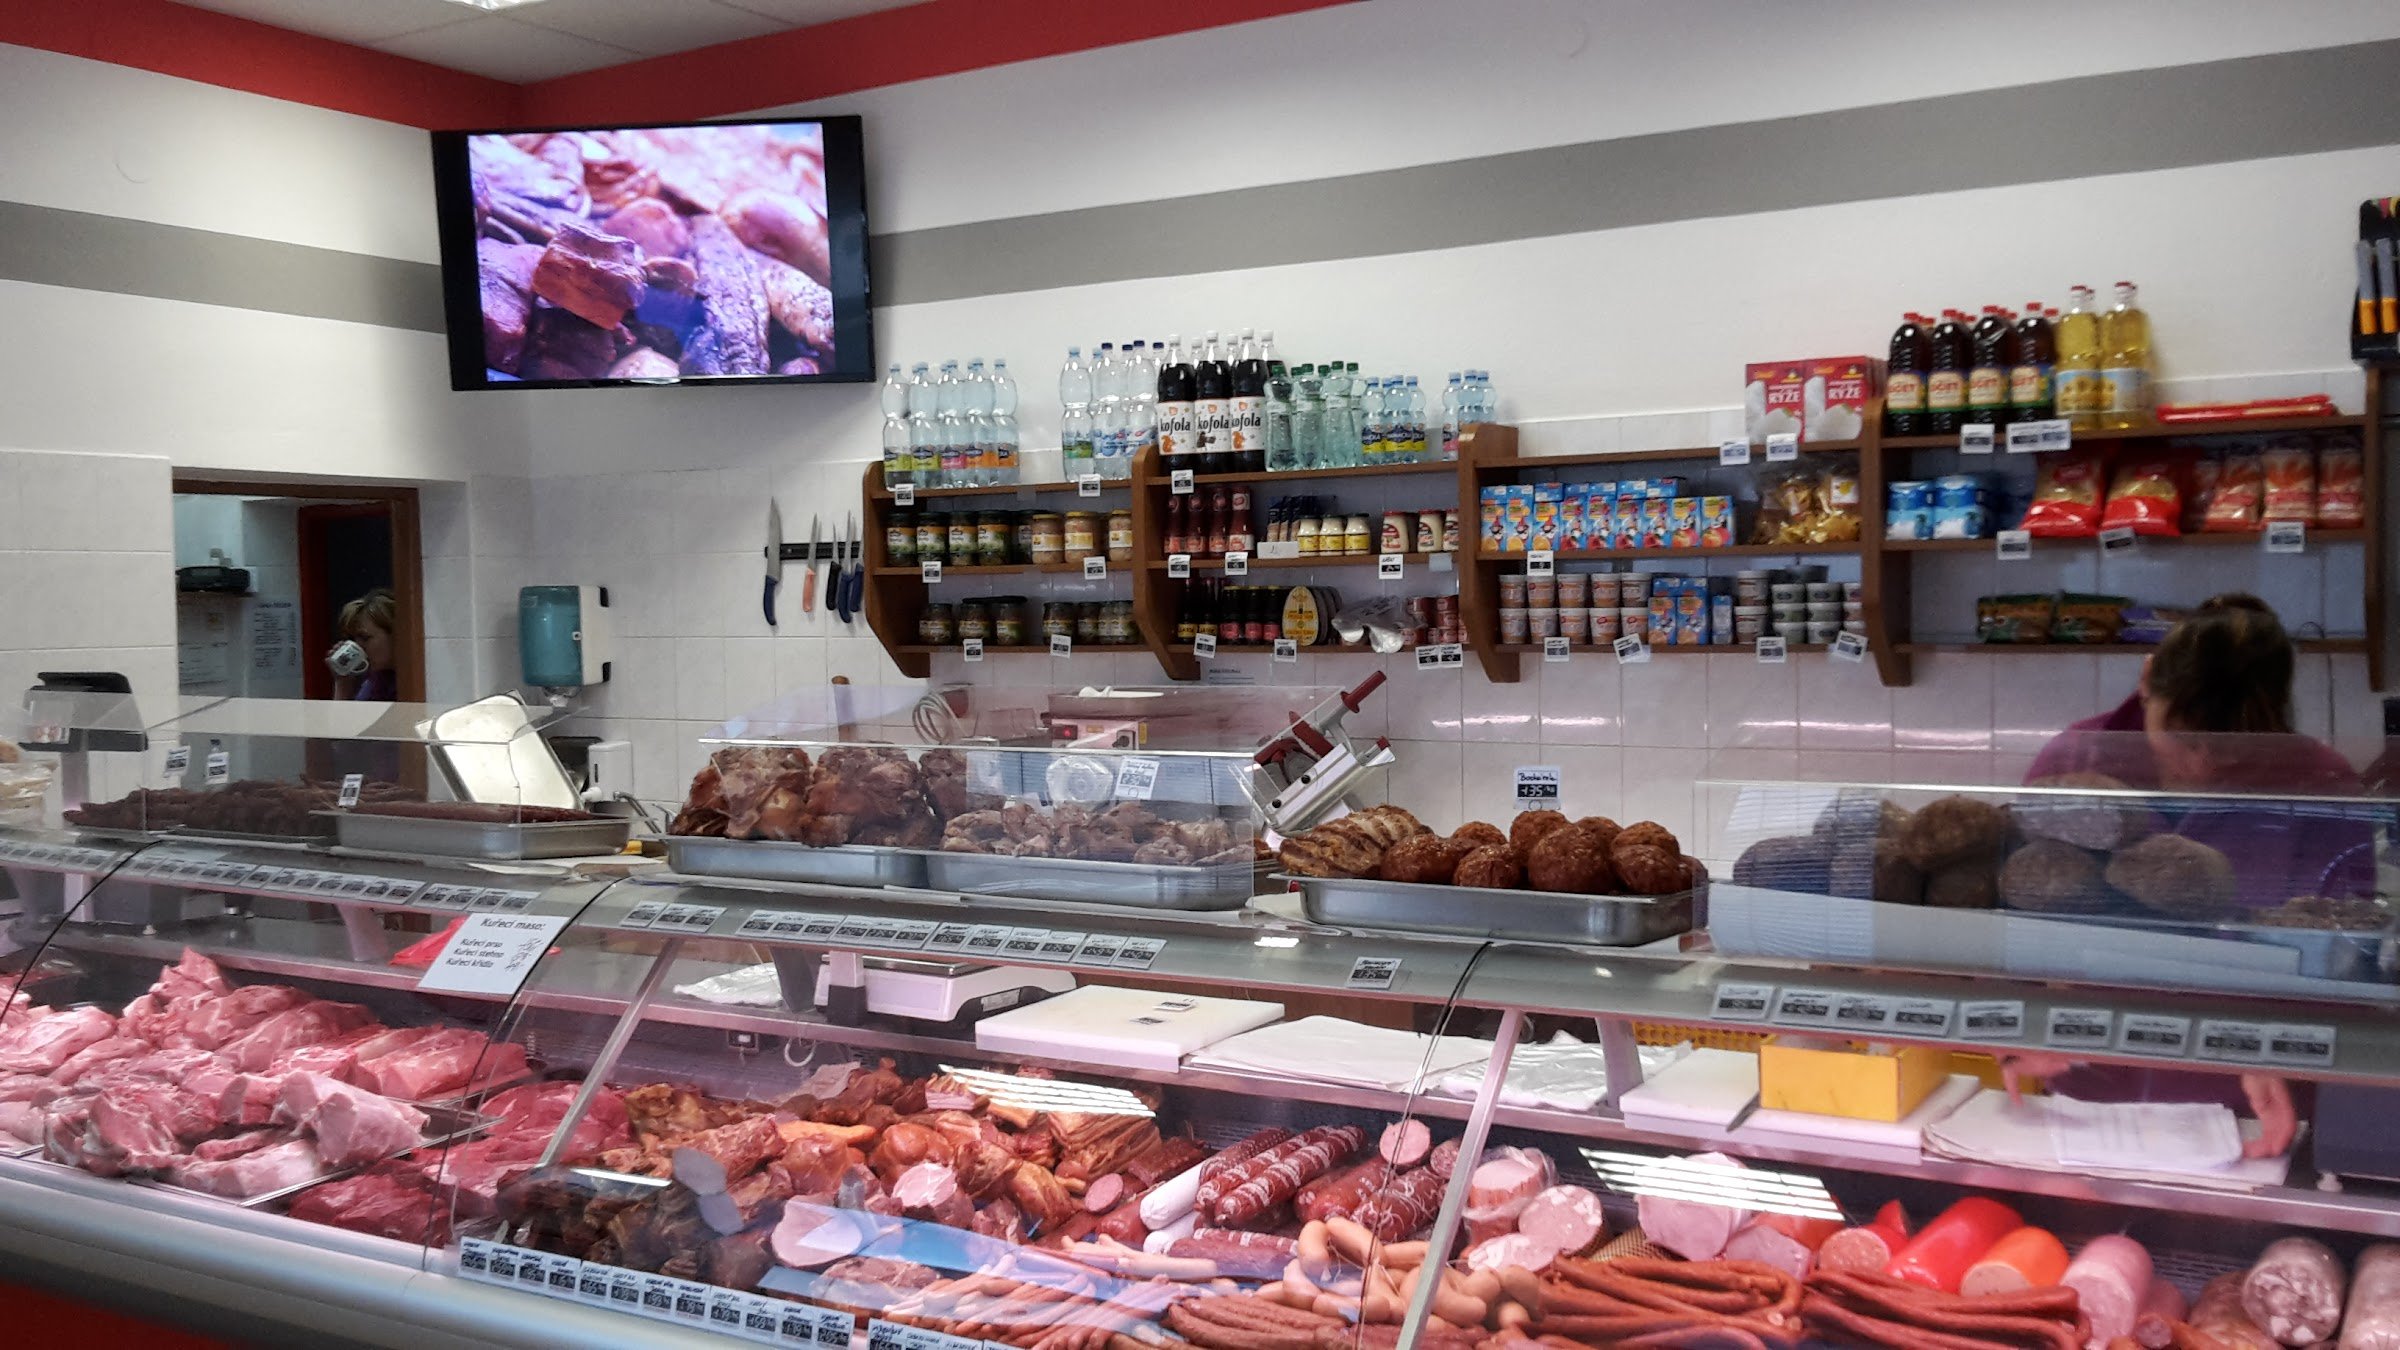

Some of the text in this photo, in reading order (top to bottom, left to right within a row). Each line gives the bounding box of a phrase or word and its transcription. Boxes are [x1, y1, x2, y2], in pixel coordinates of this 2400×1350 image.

[1160, 416, 1191, 436] kofola
[1198, 414, 1229, 433] kofola
[481, 918, 546, 931] Kuřecí maso:
[460, 938, 484, 947] Kuřecí
[453, 948, 477, 956] Kuřecí
[445, 958, 469, 967] Kuřecí
